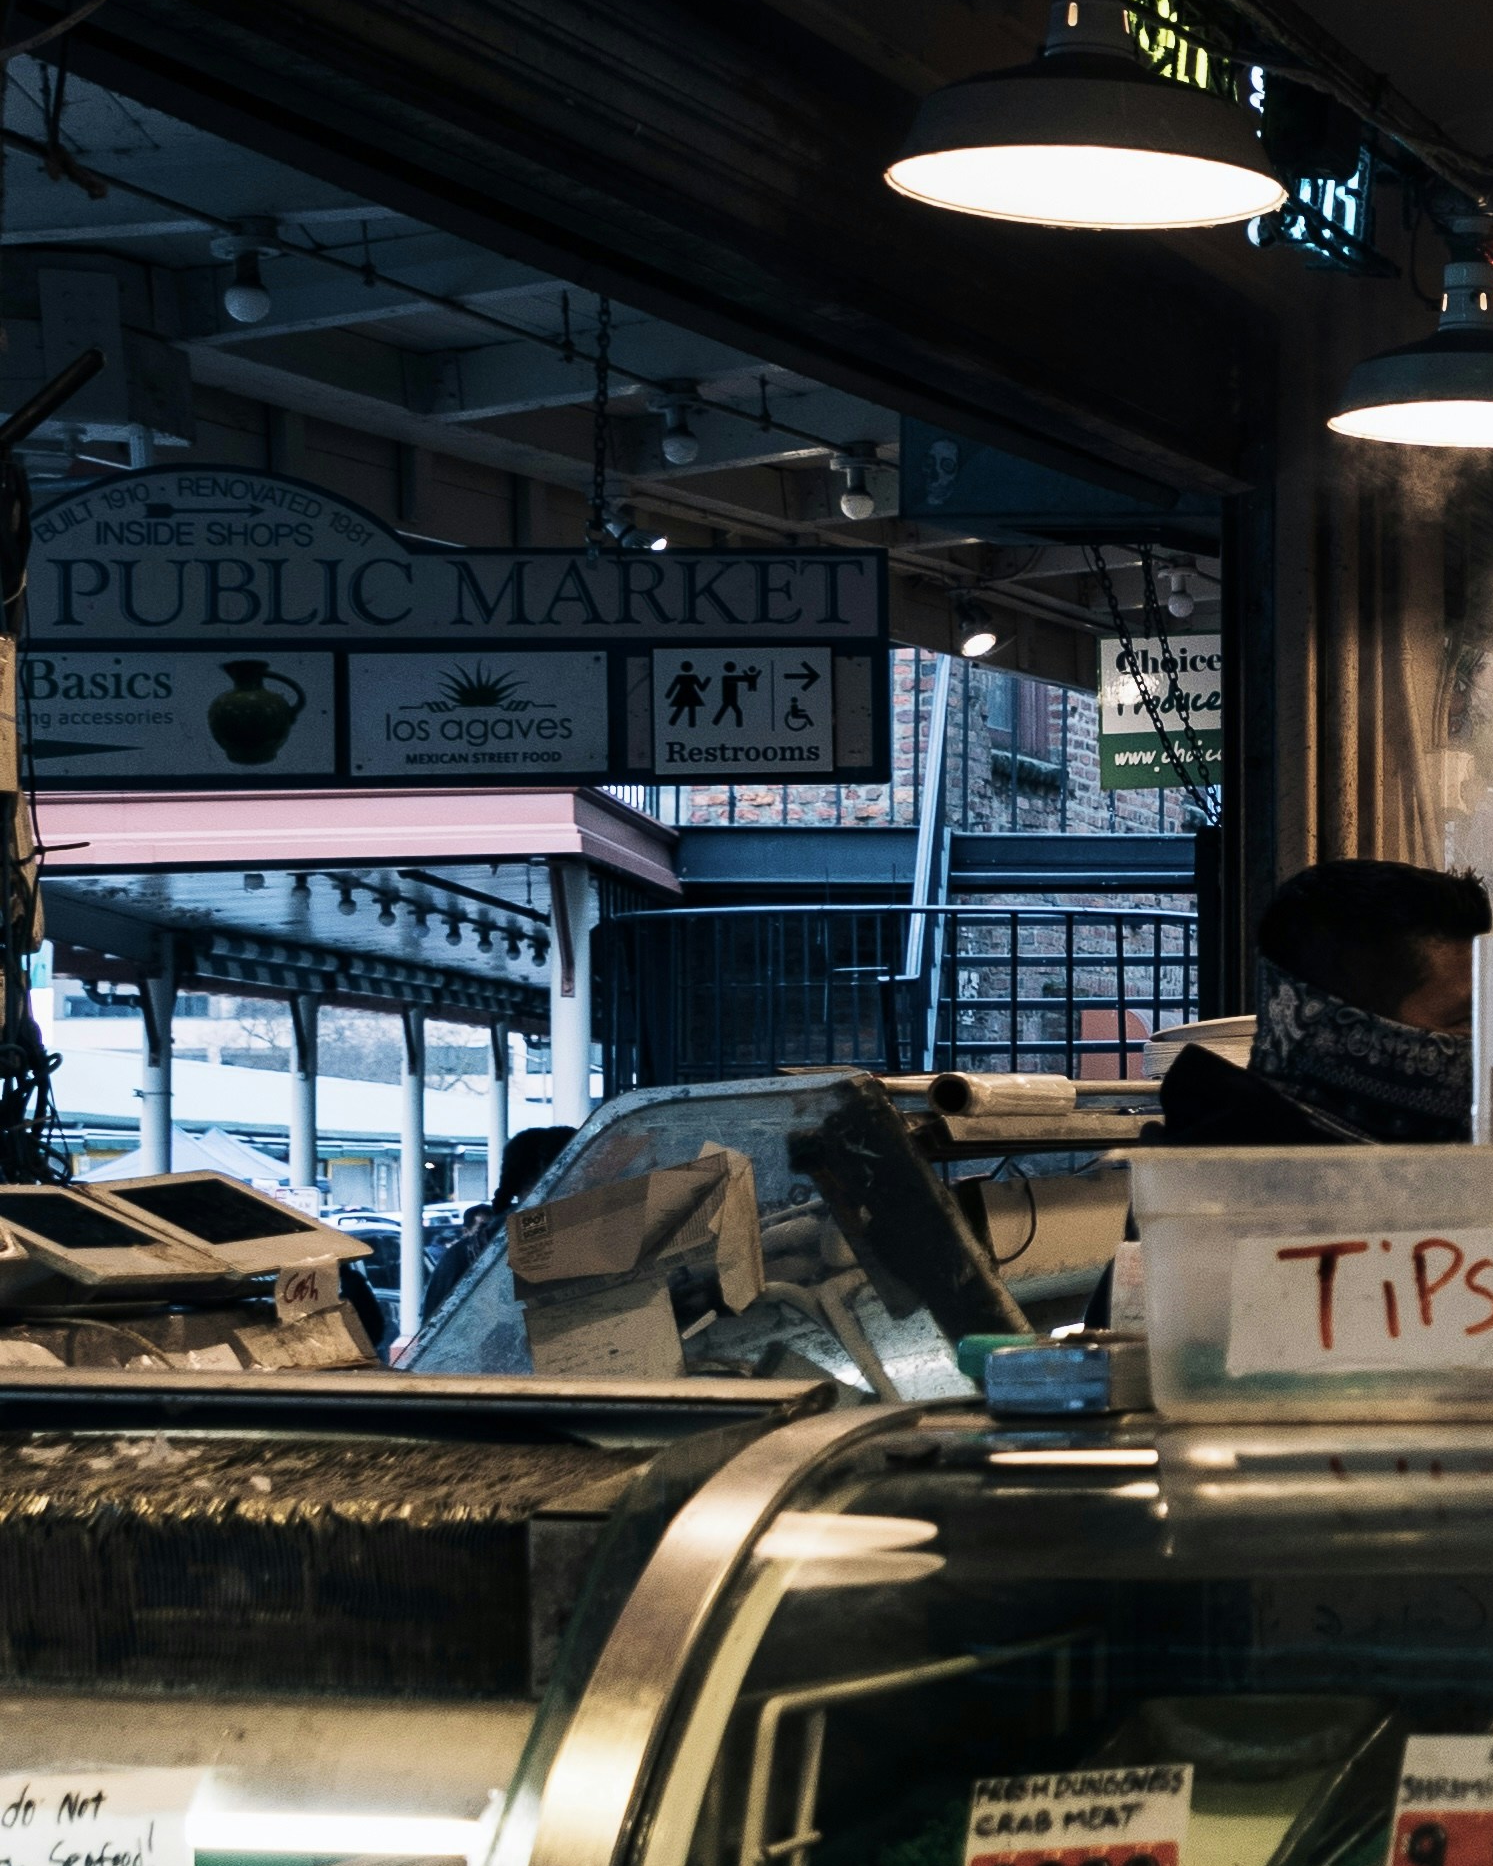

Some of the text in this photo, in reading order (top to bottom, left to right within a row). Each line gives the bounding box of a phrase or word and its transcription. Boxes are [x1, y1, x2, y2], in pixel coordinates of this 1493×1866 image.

[34, 476, 374, 547] BUILT 1910 RENOVATED 1981
[96, 521, 314, 547] INSIDE SHOPS
[47, 557, 864, 627] PUBLIC MARKET
[20, 659, 172, 700] Basics
[58, 710, 174, 725] accessories
[386, 714, 573, 747] los agaves
[405, 750, 562, 766] MEXICAN STREET FOOD
[665, 741, 820, 763] Restrooms
[975, 1800, 1146, 1837] CRAB MEAT
